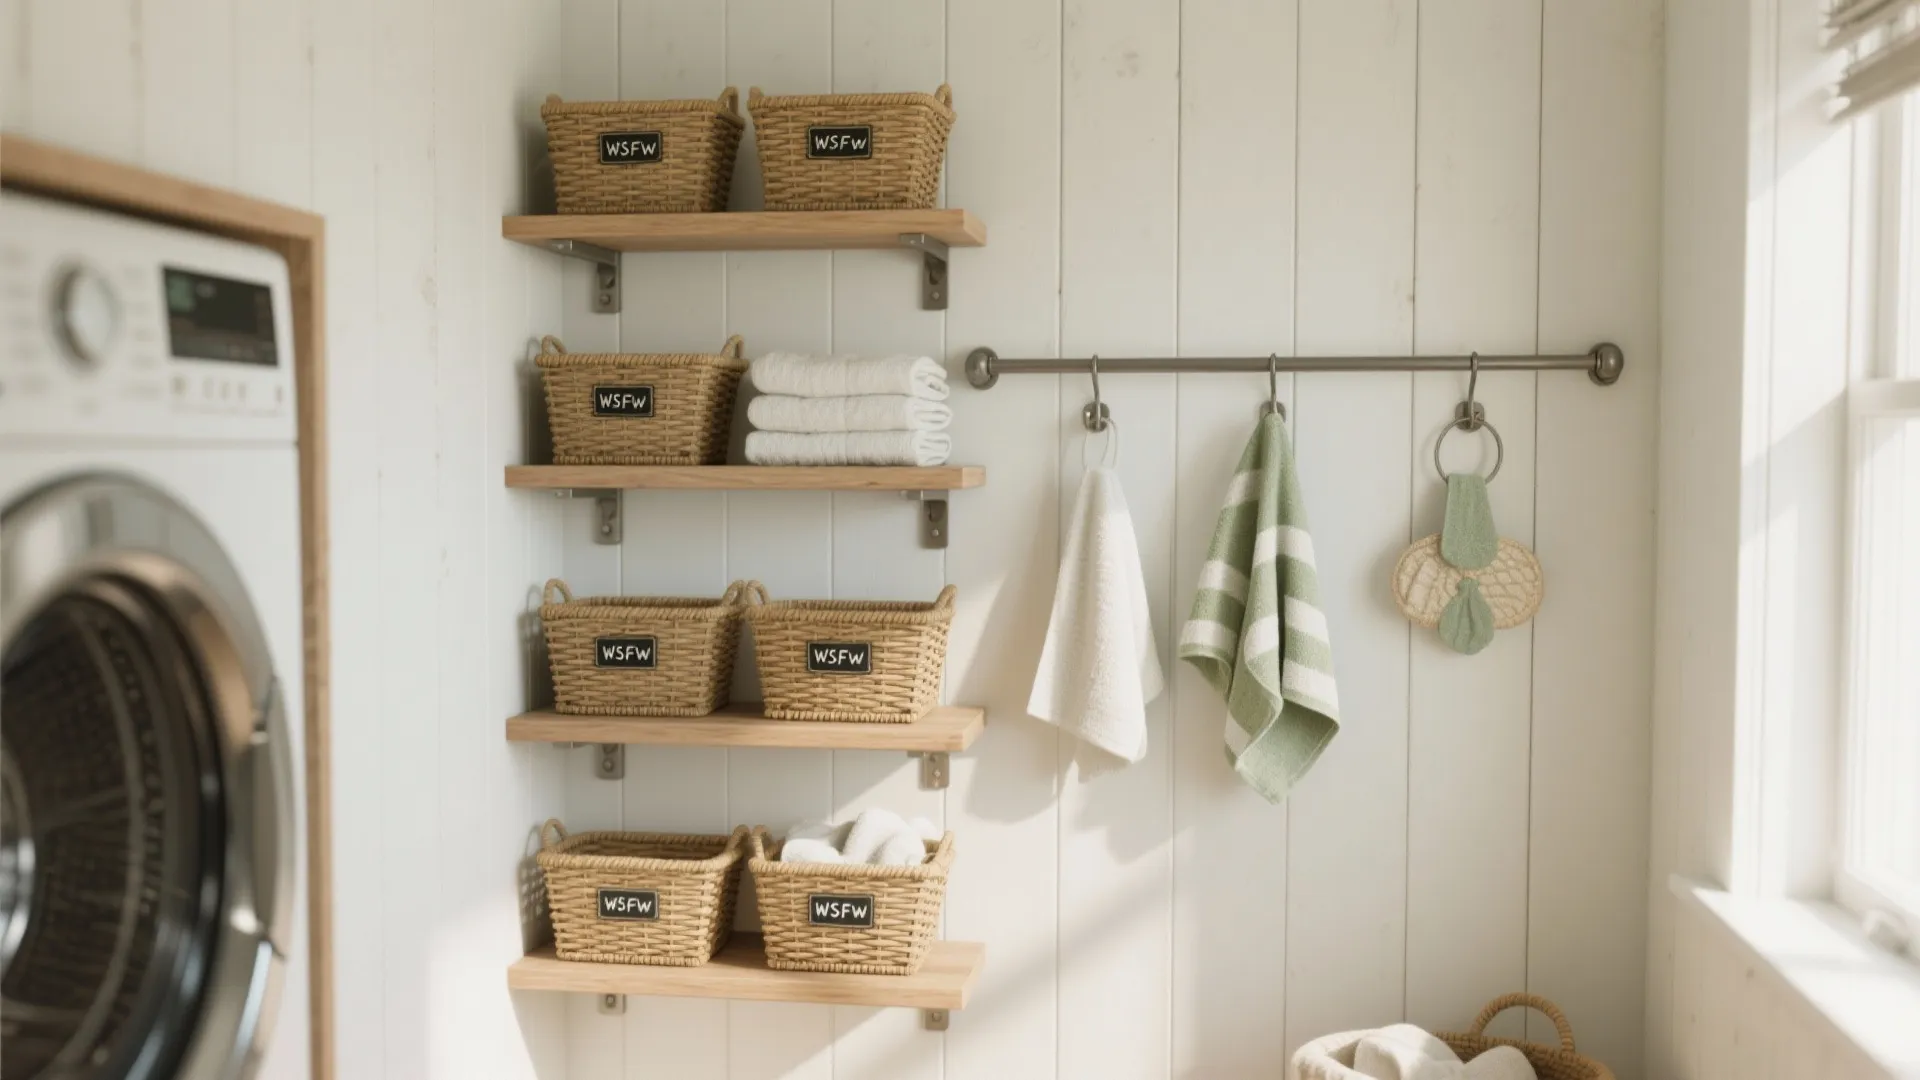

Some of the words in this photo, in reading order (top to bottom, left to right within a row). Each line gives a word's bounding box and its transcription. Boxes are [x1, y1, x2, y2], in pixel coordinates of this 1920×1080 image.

[606, 140, 657, 156] WSFW
[599, 393, 646, 409] WSFW
[602, 645, 651, 661] WSFW
[814, 648, 864, 665] WSFW
[604, 896, 652, 913] WSFW
[815, 901, 868, 919] WSFW
